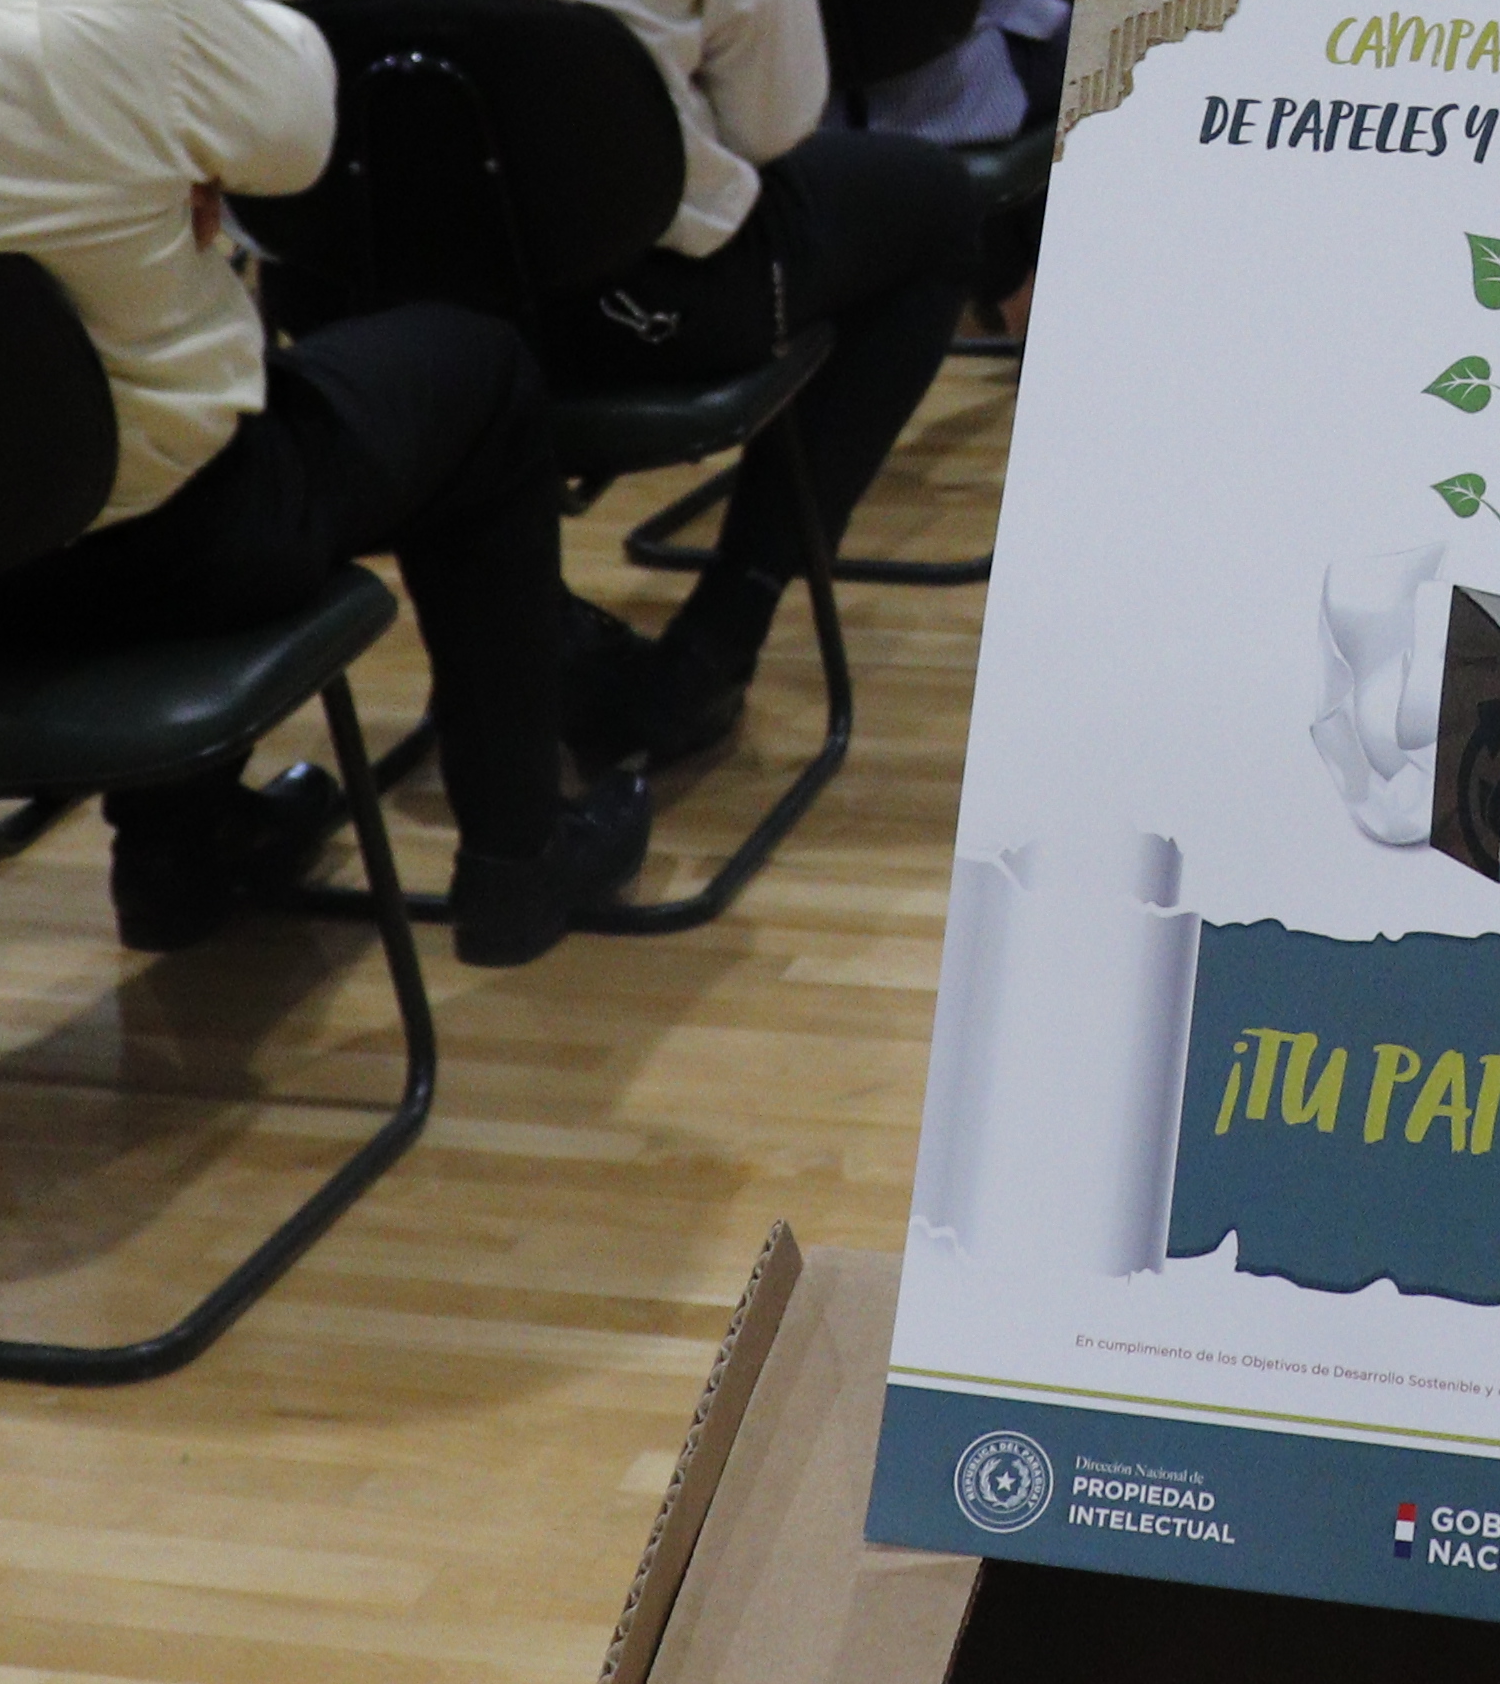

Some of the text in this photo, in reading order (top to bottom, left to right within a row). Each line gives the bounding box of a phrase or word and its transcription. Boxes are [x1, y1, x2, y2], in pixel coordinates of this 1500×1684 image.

[1199, 96, 1262, 145] DE
[1266, 97, 1460, 157] PAPELES
[1464, 104, 1499, 164] Y
[1213, 1027, 1348, 1135] ¡TU
[1075, 1334, 1094, 1348] En
[1097, 1338, 1193, 1360] cumplimiento
[1196, 1347, 1214, 1363] de
[1217, 1350, 1238, 1367] los
[1241, 1354, 1308, 1375] Objetivos
[1311, 1361, 1330, 1377] de
[1333, 1365, 1405, 1386] Desarrollo
[1408, 1373, 1482, 1395] Sostenible
[1485, 1386, 1495, 1399] y
[1071, 1475, 1216, 1513] PROPIEDAD
[1075, 1454, 1204, 1486] Dirección Nacional de
[1067, 1503, 1236, 1545] INTELECTUAL
